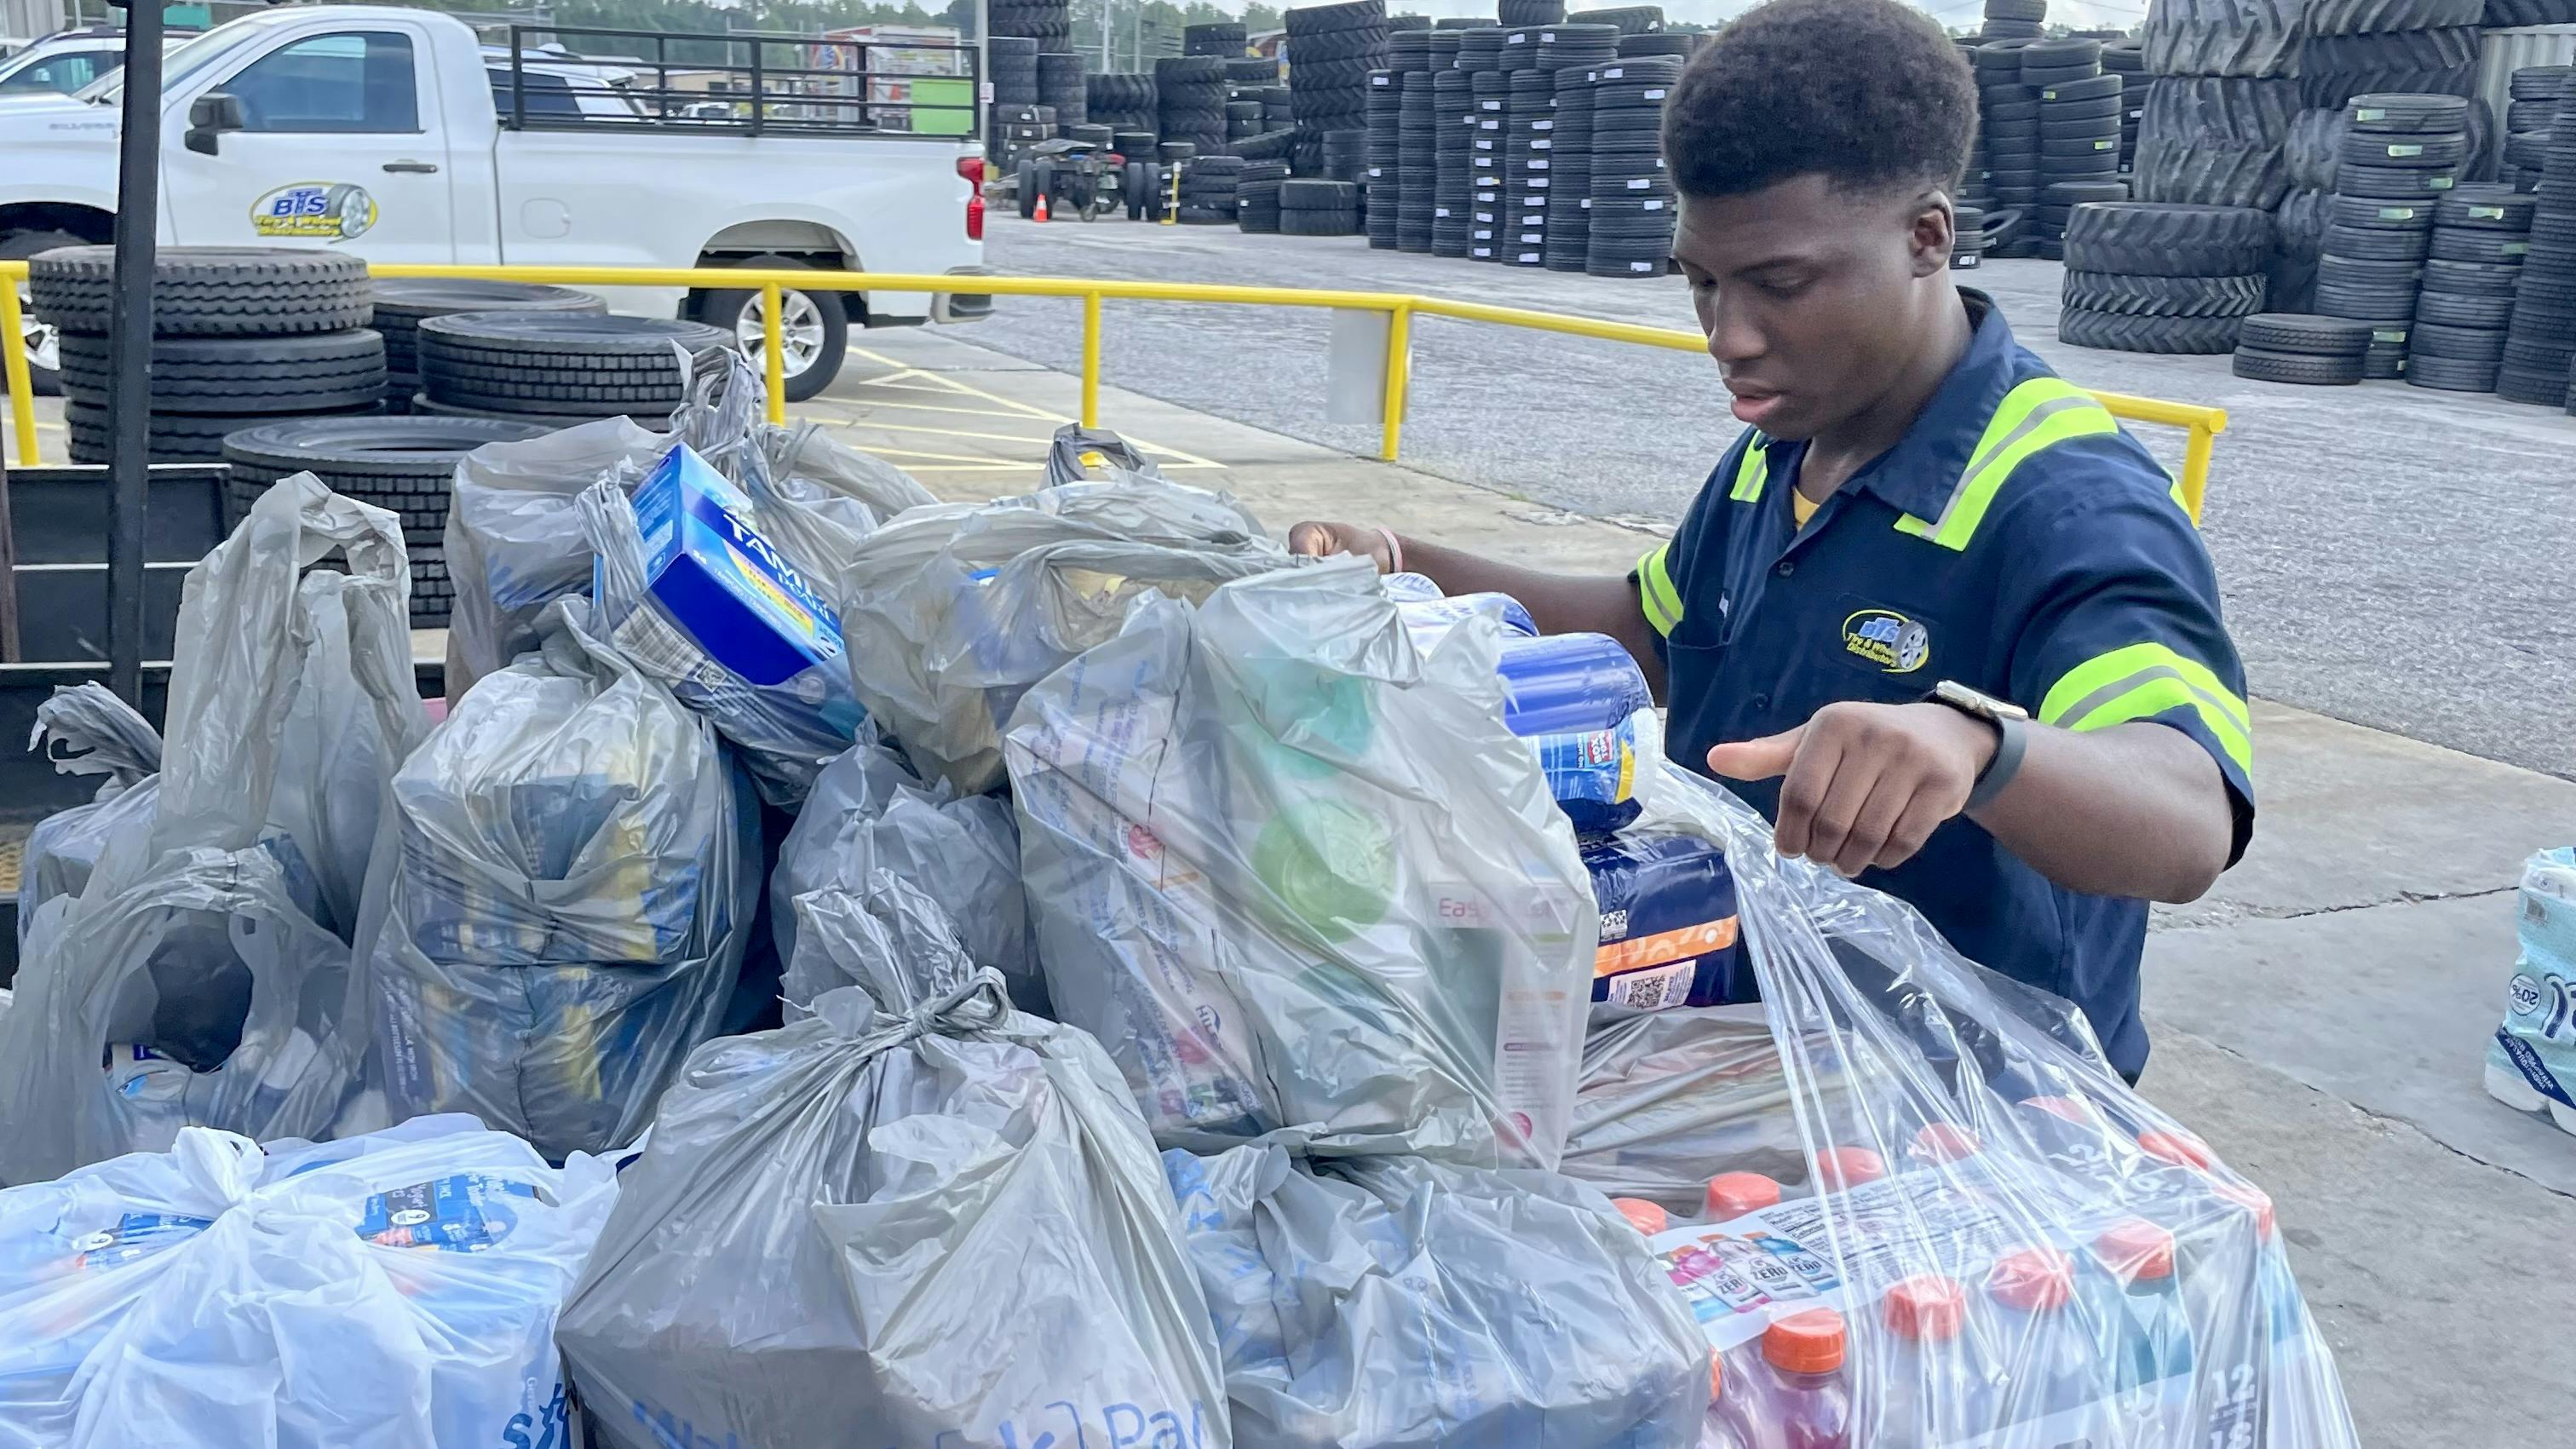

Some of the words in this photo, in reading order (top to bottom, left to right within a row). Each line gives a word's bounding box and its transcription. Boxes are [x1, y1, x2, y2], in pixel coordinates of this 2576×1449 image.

[272, 189, 326, 216] BTS
[1590, 738, 1602, 764] BOX
[2513, 984, 2539, 1006] 20%
[1751, 1264, 1788, 1279] ZERO
[2211, 1363, 2256, 1409] 12
